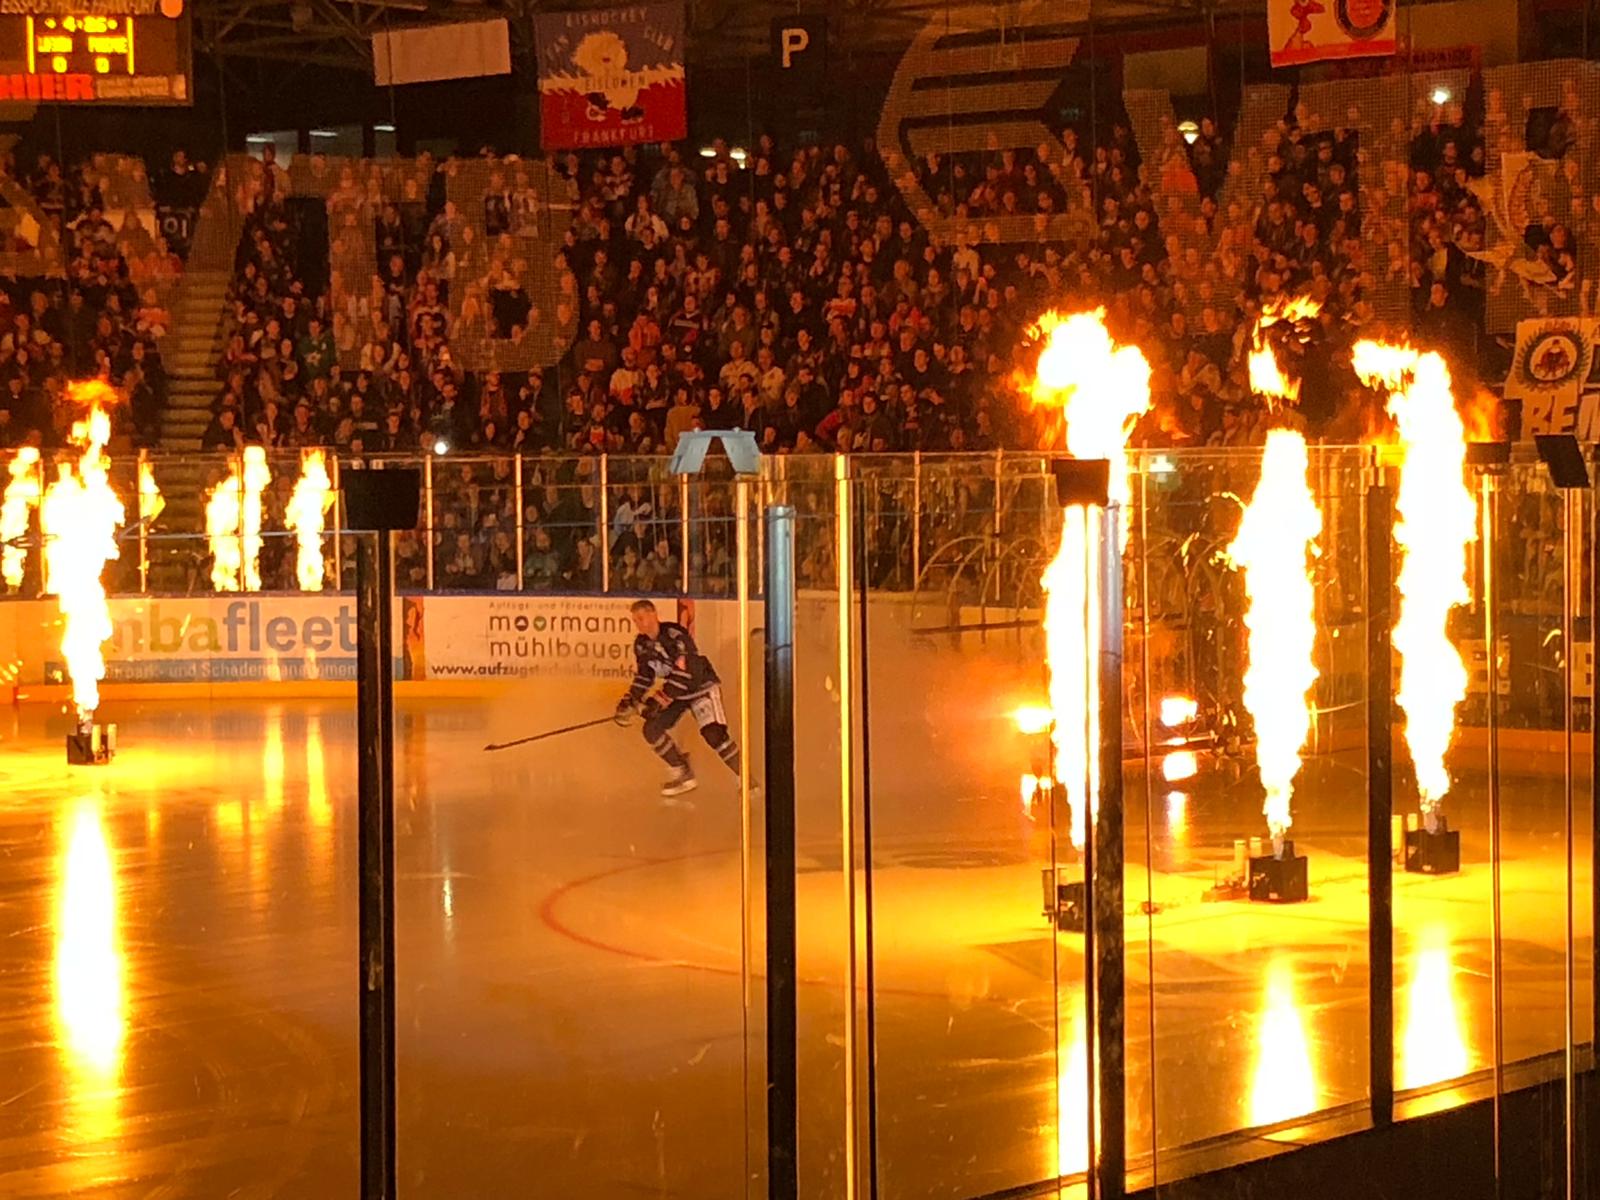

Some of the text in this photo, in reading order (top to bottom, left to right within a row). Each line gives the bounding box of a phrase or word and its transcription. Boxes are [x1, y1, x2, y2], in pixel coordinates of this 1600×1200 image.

[782, 28, 809, 68] P
[573, 124, 654, 143] FRANKFURT
[490, 636, 631, 660] mühlbauer
[168, 662, 197, 678] und
